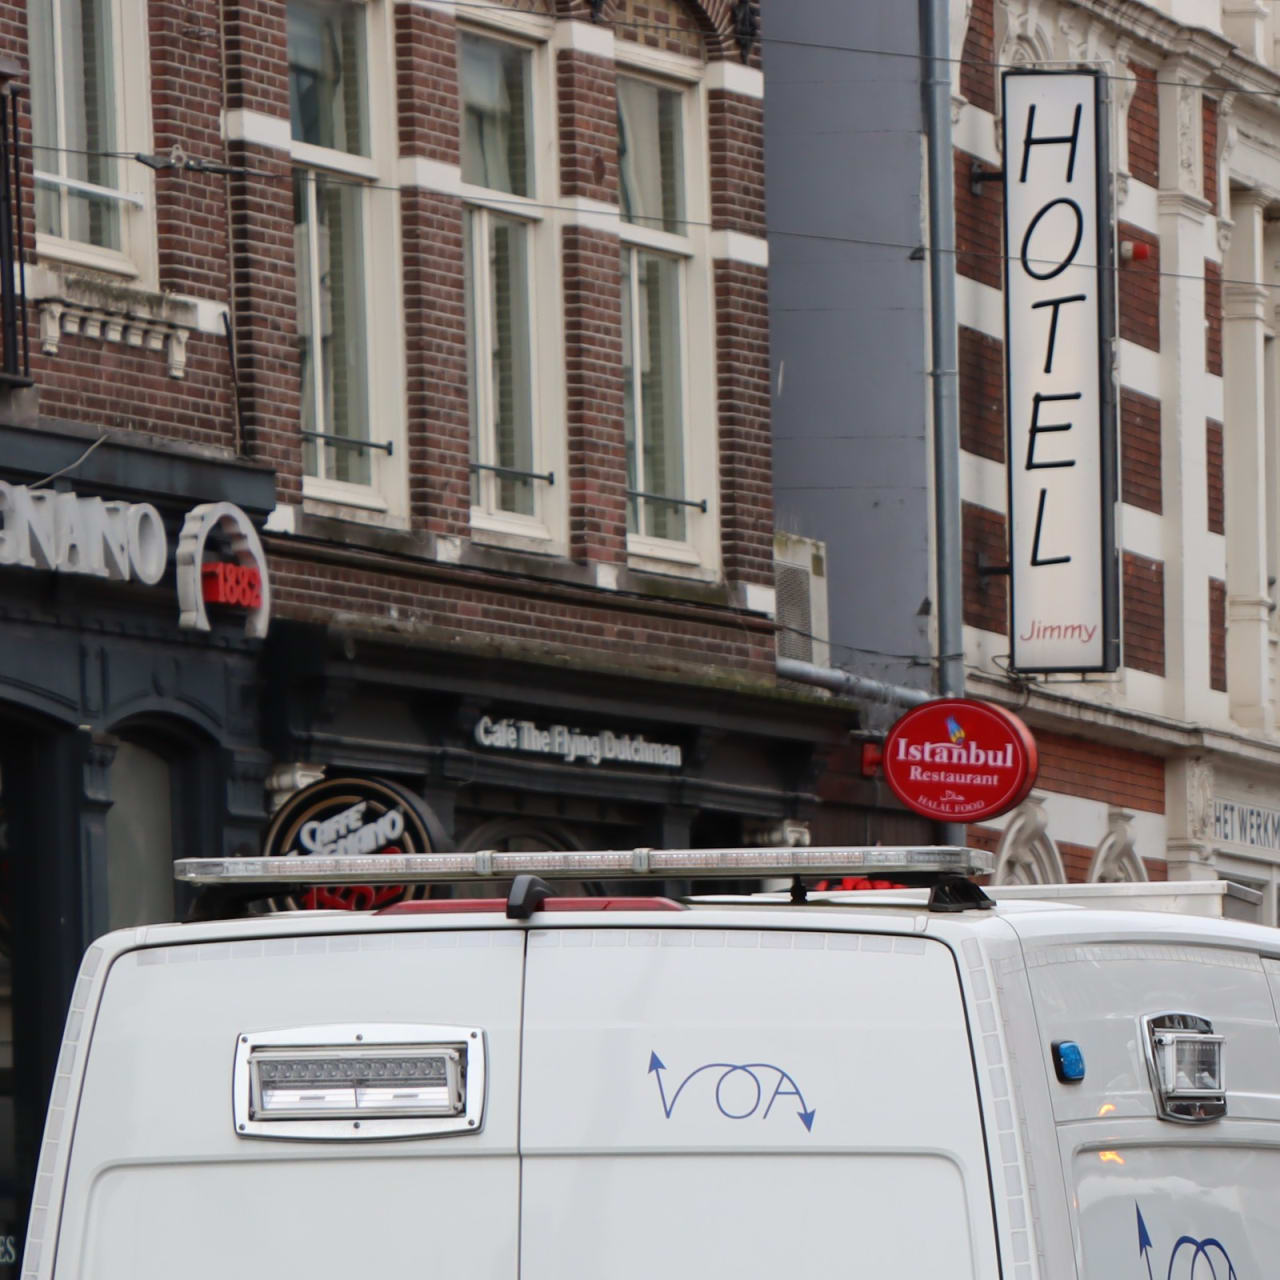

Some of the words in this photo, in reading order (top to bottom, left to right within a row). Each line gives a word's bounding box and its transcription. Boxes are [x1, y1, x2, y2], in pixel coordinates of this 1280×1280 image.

[1019, 103, 1087, 567] HOTEL
[217, 564, 262, 608] 1882
[1020, 620, 1097, 644] Jimmy
[475, 715, 517, 748] Café
[518, 719, 550, 752] The
[551, 724, 600, 765] Flying
[601, 730, 683, 767] Dutchman
[896, 738, 1014, 768] Istanbul
[910, 766, 999, 786] Restaurant
[918, 795, 952, 813] HALAL
[954, 799, 985, 813] FOOD
[1214, 801, 1235, 841] HET
[648, 1050, 816, 1132] VOA
